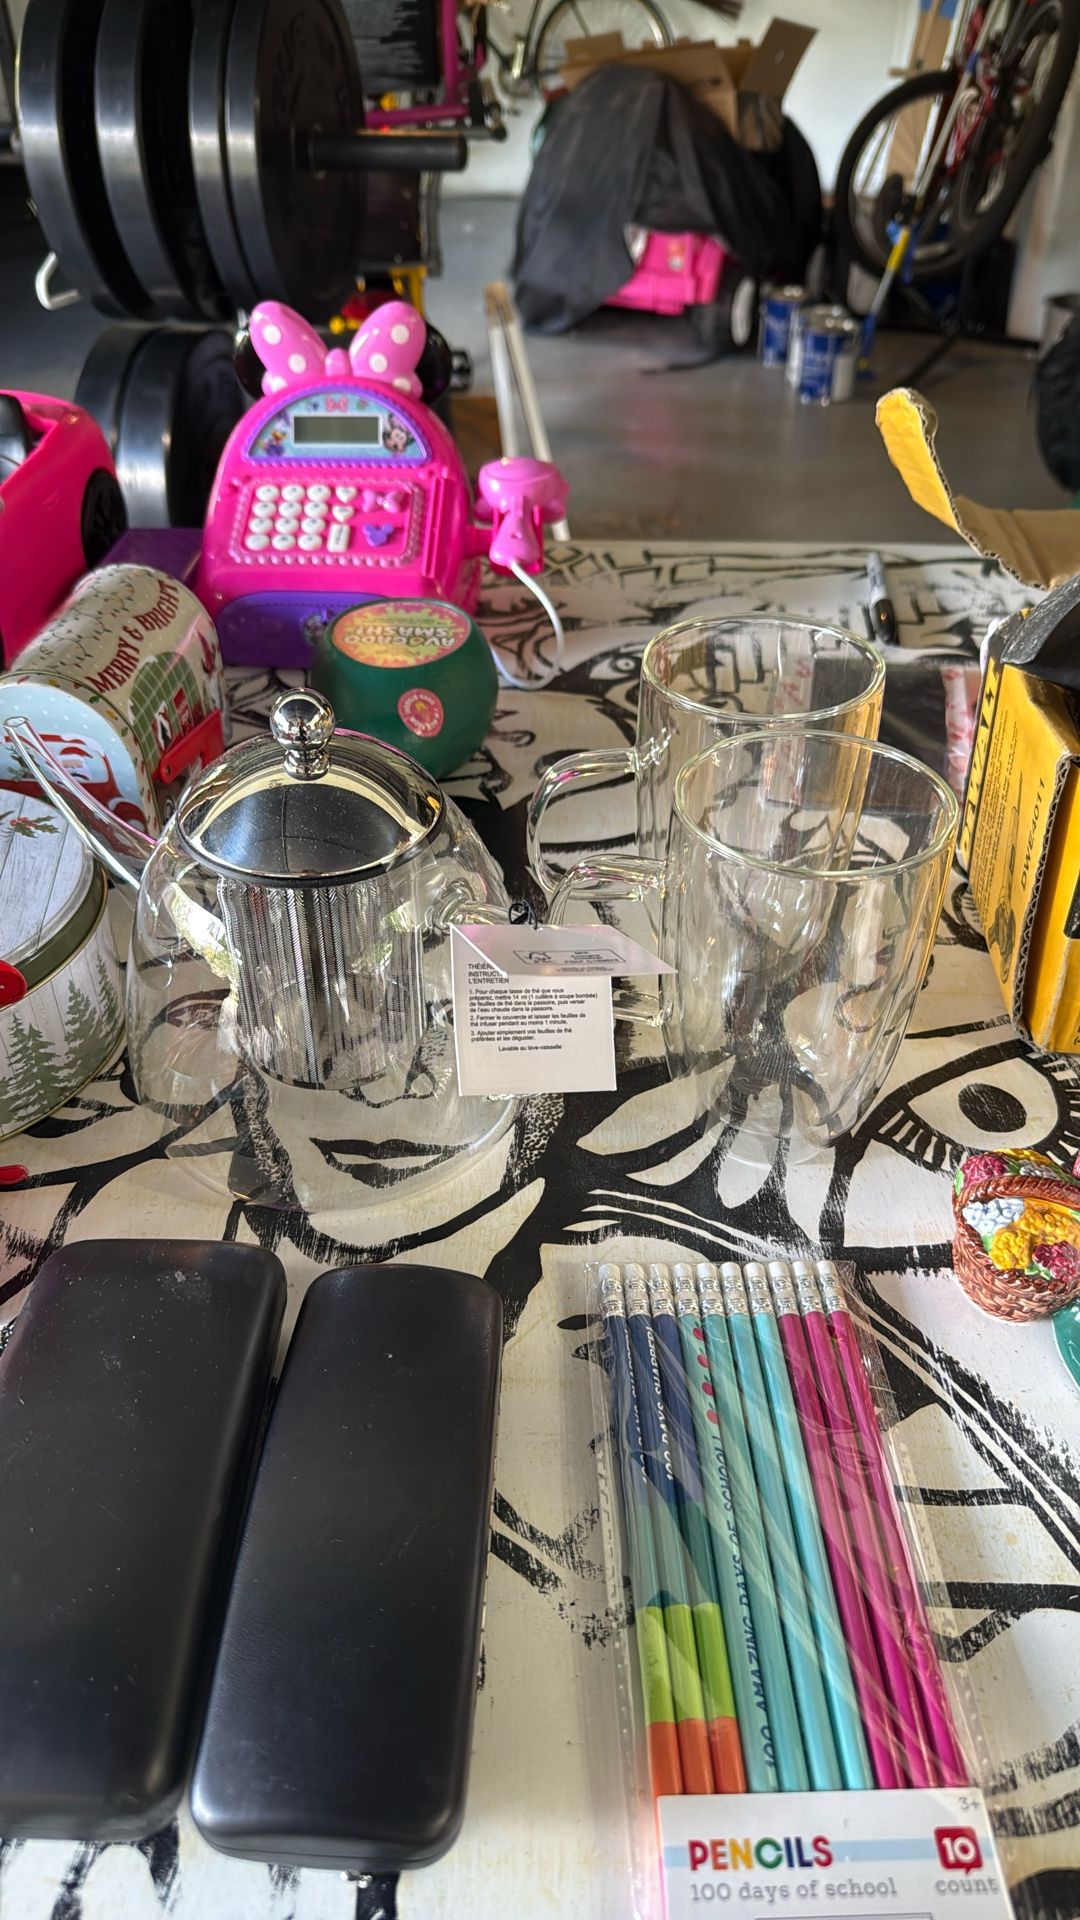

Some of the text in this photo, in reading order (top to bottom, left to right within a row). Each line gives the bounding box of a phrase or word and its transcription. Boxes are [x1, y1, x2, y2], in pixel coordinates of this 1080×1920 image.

[85, 580, 180, 693] MERRY & BRIGHT
[344, 635, 455, 647] AVOCADO
[355, 626, 450, 636] SMASH!
[1019, 776, 1046, 891] DWE4011
[958, 1796, 981, 1811] 3+
[688, 1835, 834, 1872] PENCILS
[942, 1835, 976, 1863] 10
[690, 1876, 898, 1905] 100 days of school
[935, 1876, 1000, 1895] count
